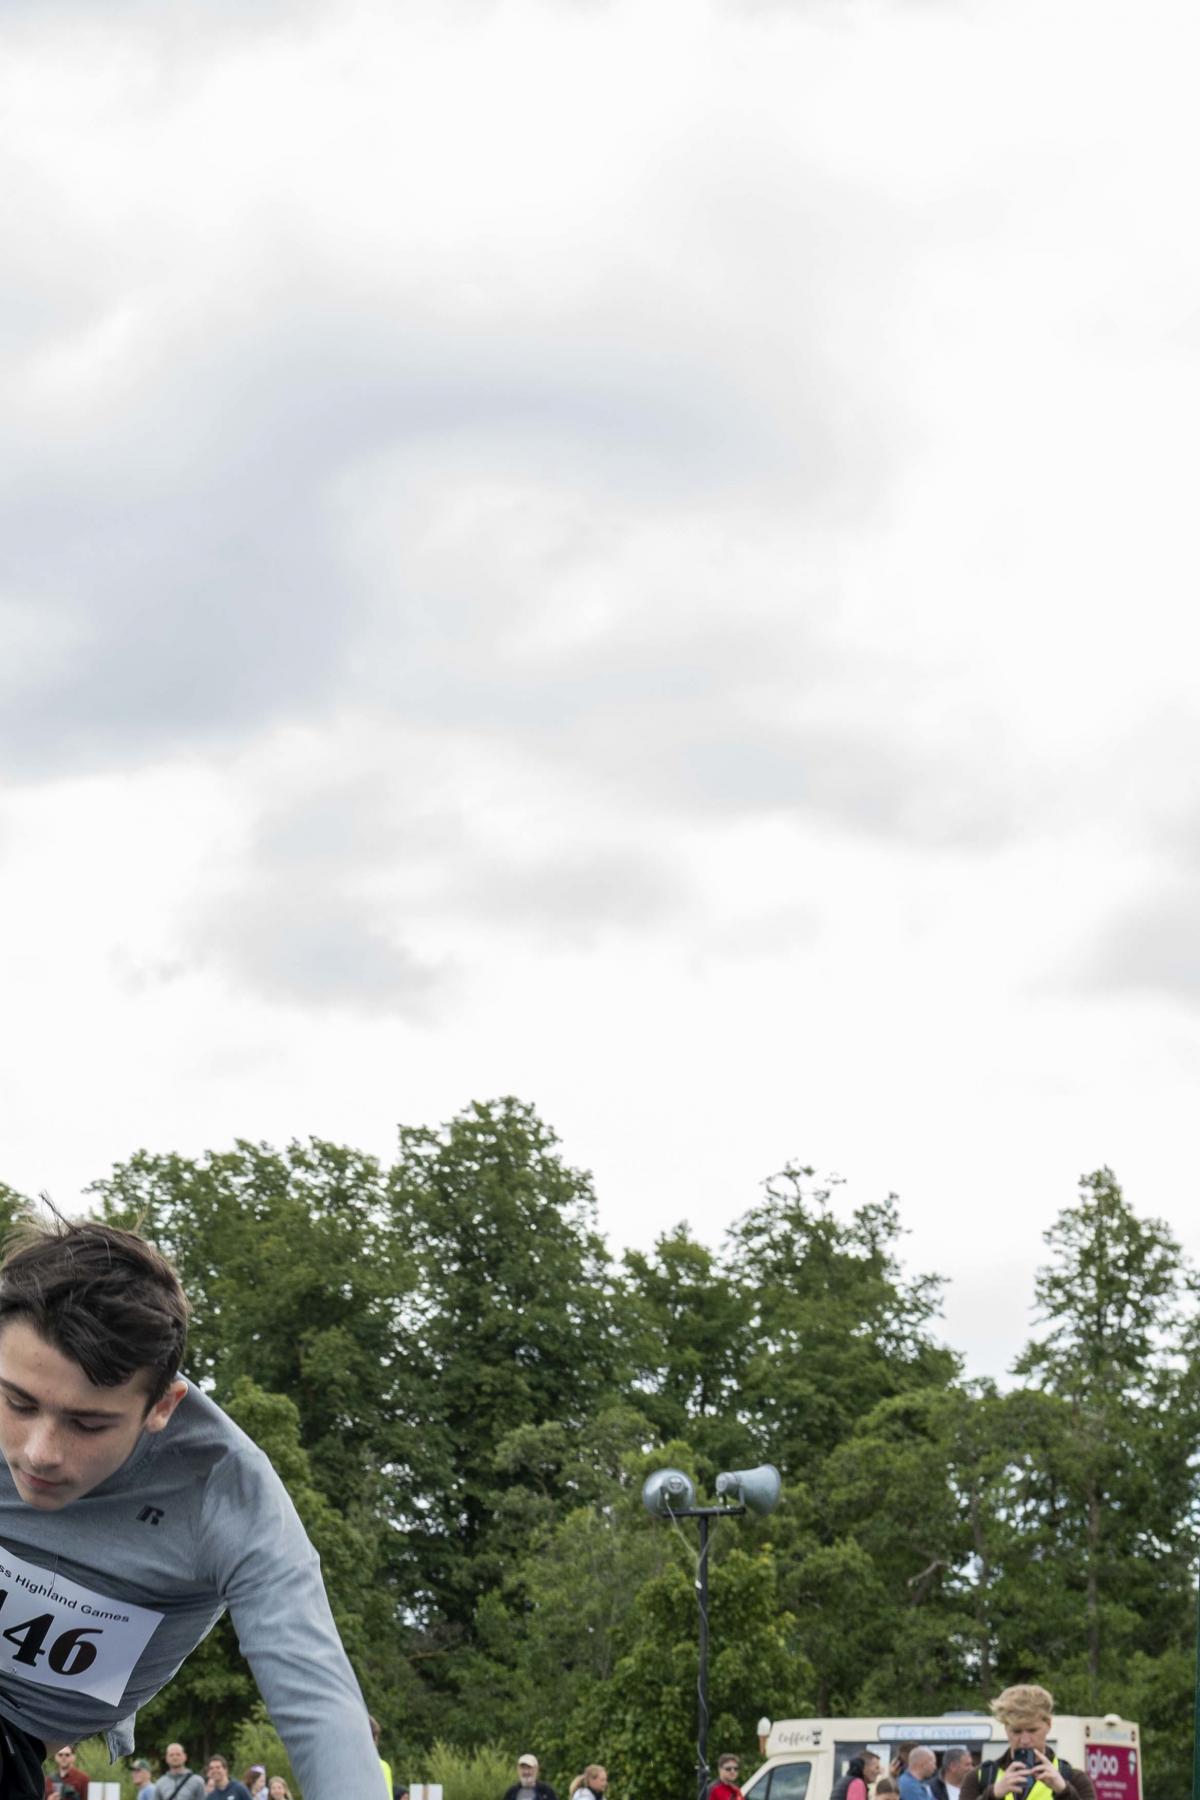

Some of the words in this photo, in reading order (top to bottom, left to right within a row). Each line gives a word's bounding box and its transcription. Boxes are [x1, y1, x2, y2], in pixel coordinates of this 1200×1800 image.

[15, 1574, 78, 1610] Highland
[80, 1604, 130, 1623] Games
[778, 1731, 811, 1746] Coffee
